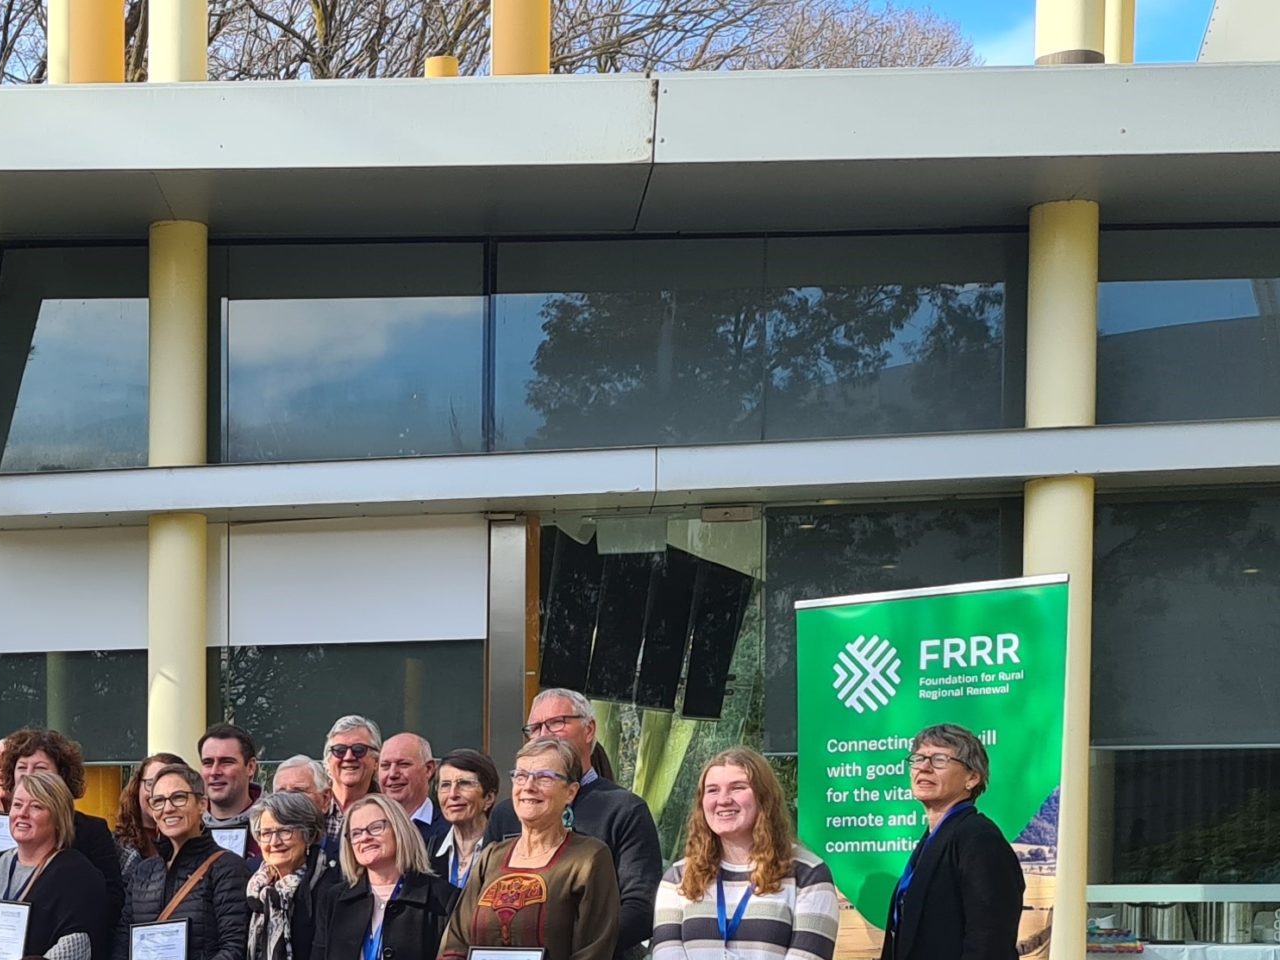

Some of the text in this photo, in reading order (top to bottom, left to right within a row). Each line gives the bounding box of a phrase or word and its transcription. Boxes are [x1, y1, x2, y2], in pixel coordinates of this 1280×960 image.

[919, 632, 1021, 670] FRRR
[919, 669, 1024, 686] Foundation for Rural
[919, 683, 1009, 700] Regional Renewal
[977, 730, 997, 745] ill
[826, 761, 905, 780] with good
[826, 785, 917, 803] for the vita
[826, 813, 884, 828] remote
[887, 811, 917, 826] and
